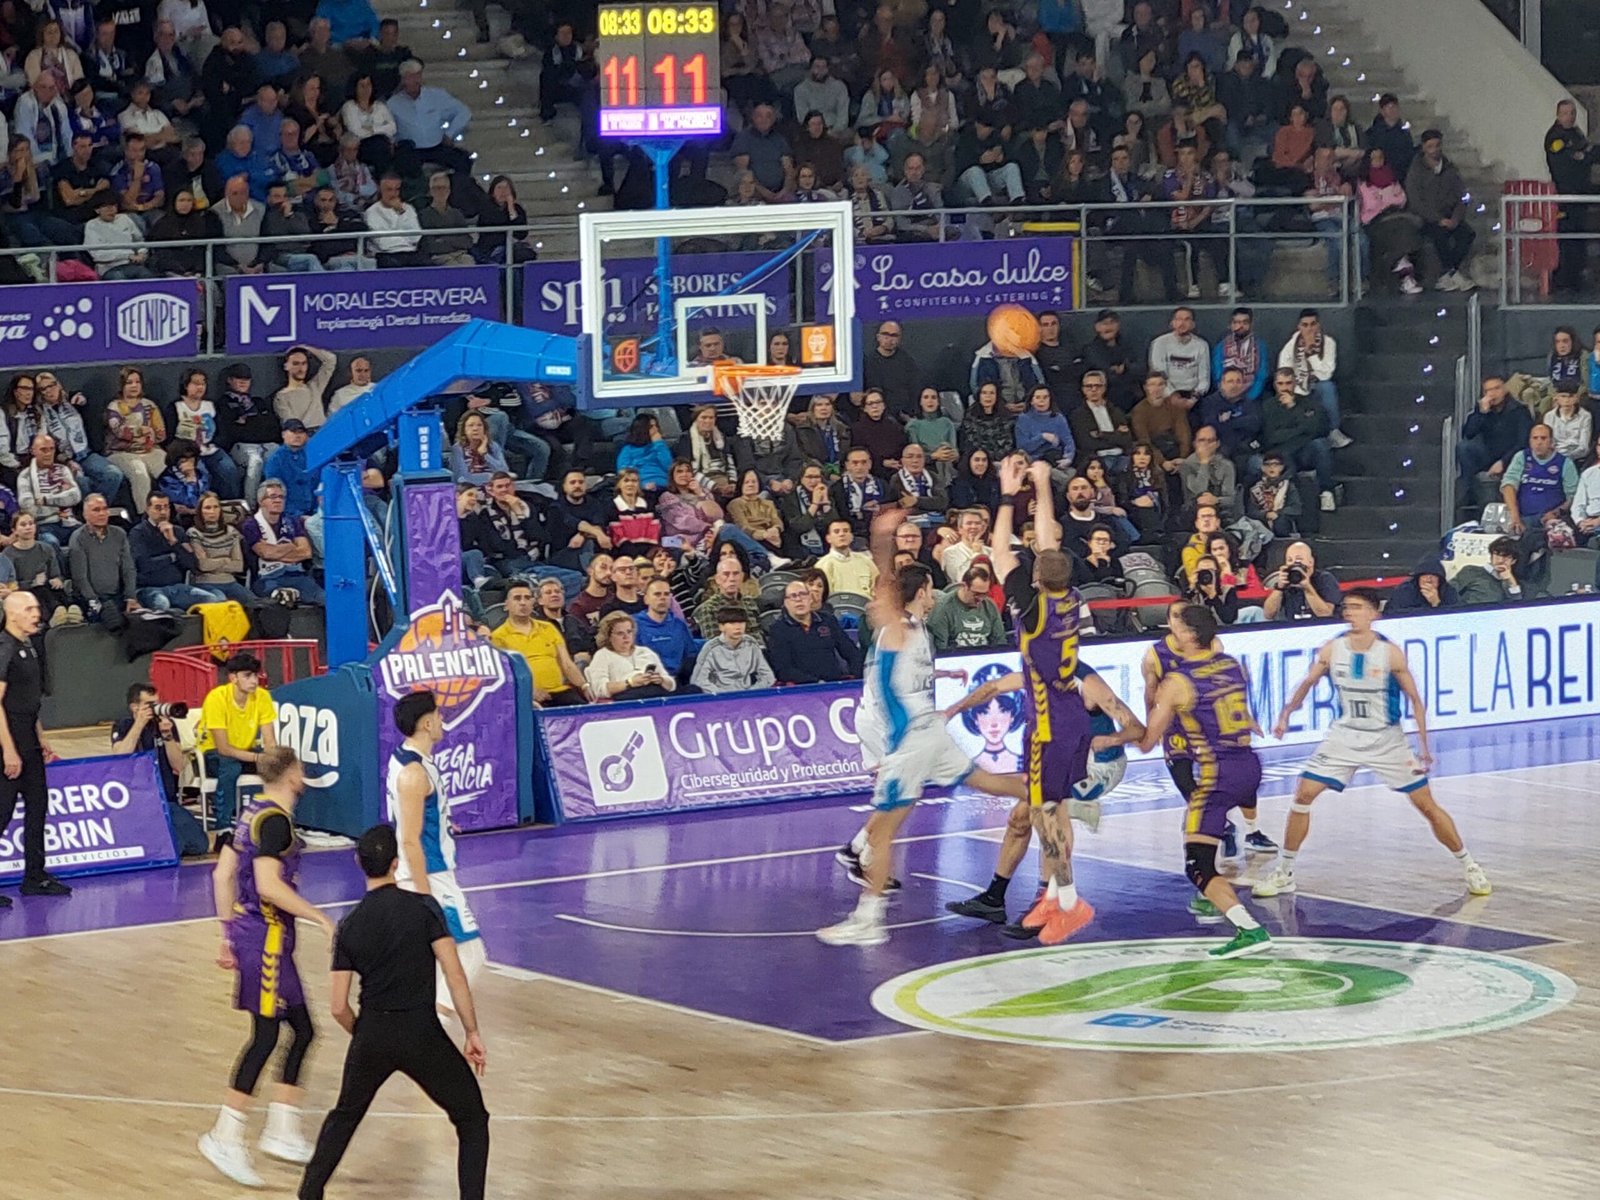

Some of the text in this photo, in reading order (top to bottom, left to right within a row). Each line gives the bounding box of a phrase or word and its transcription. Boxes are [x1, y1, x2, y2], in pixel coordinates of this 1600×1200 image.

[600, 7, 714, 35] 08:33 08:33
[604, 53, 707, 106] 11 11
[645, 272, 743, 296] SBORES
[871, 247, 1069, 291] La casa dulce
[304, 286, 487, 313] MORALESCERVERA
[895, 296, 971, 308] CONFITERIA
[985, 291, 1049, 304] CATERING
[120, 299, 187, 341] TECNIPEC
[388, 645, 497, 685] PALENCIA
[1059, 634, 1079, 679] 5
[669, 697, 861, 766] Grupo C
[440, 762, 493, 795] ENCIA
[681, 758, 860, 790] Ciberseguridad y Protección
[12, 781, 130, 820] ERERO
[12, 850, 129, 869] MISERVICIOS
